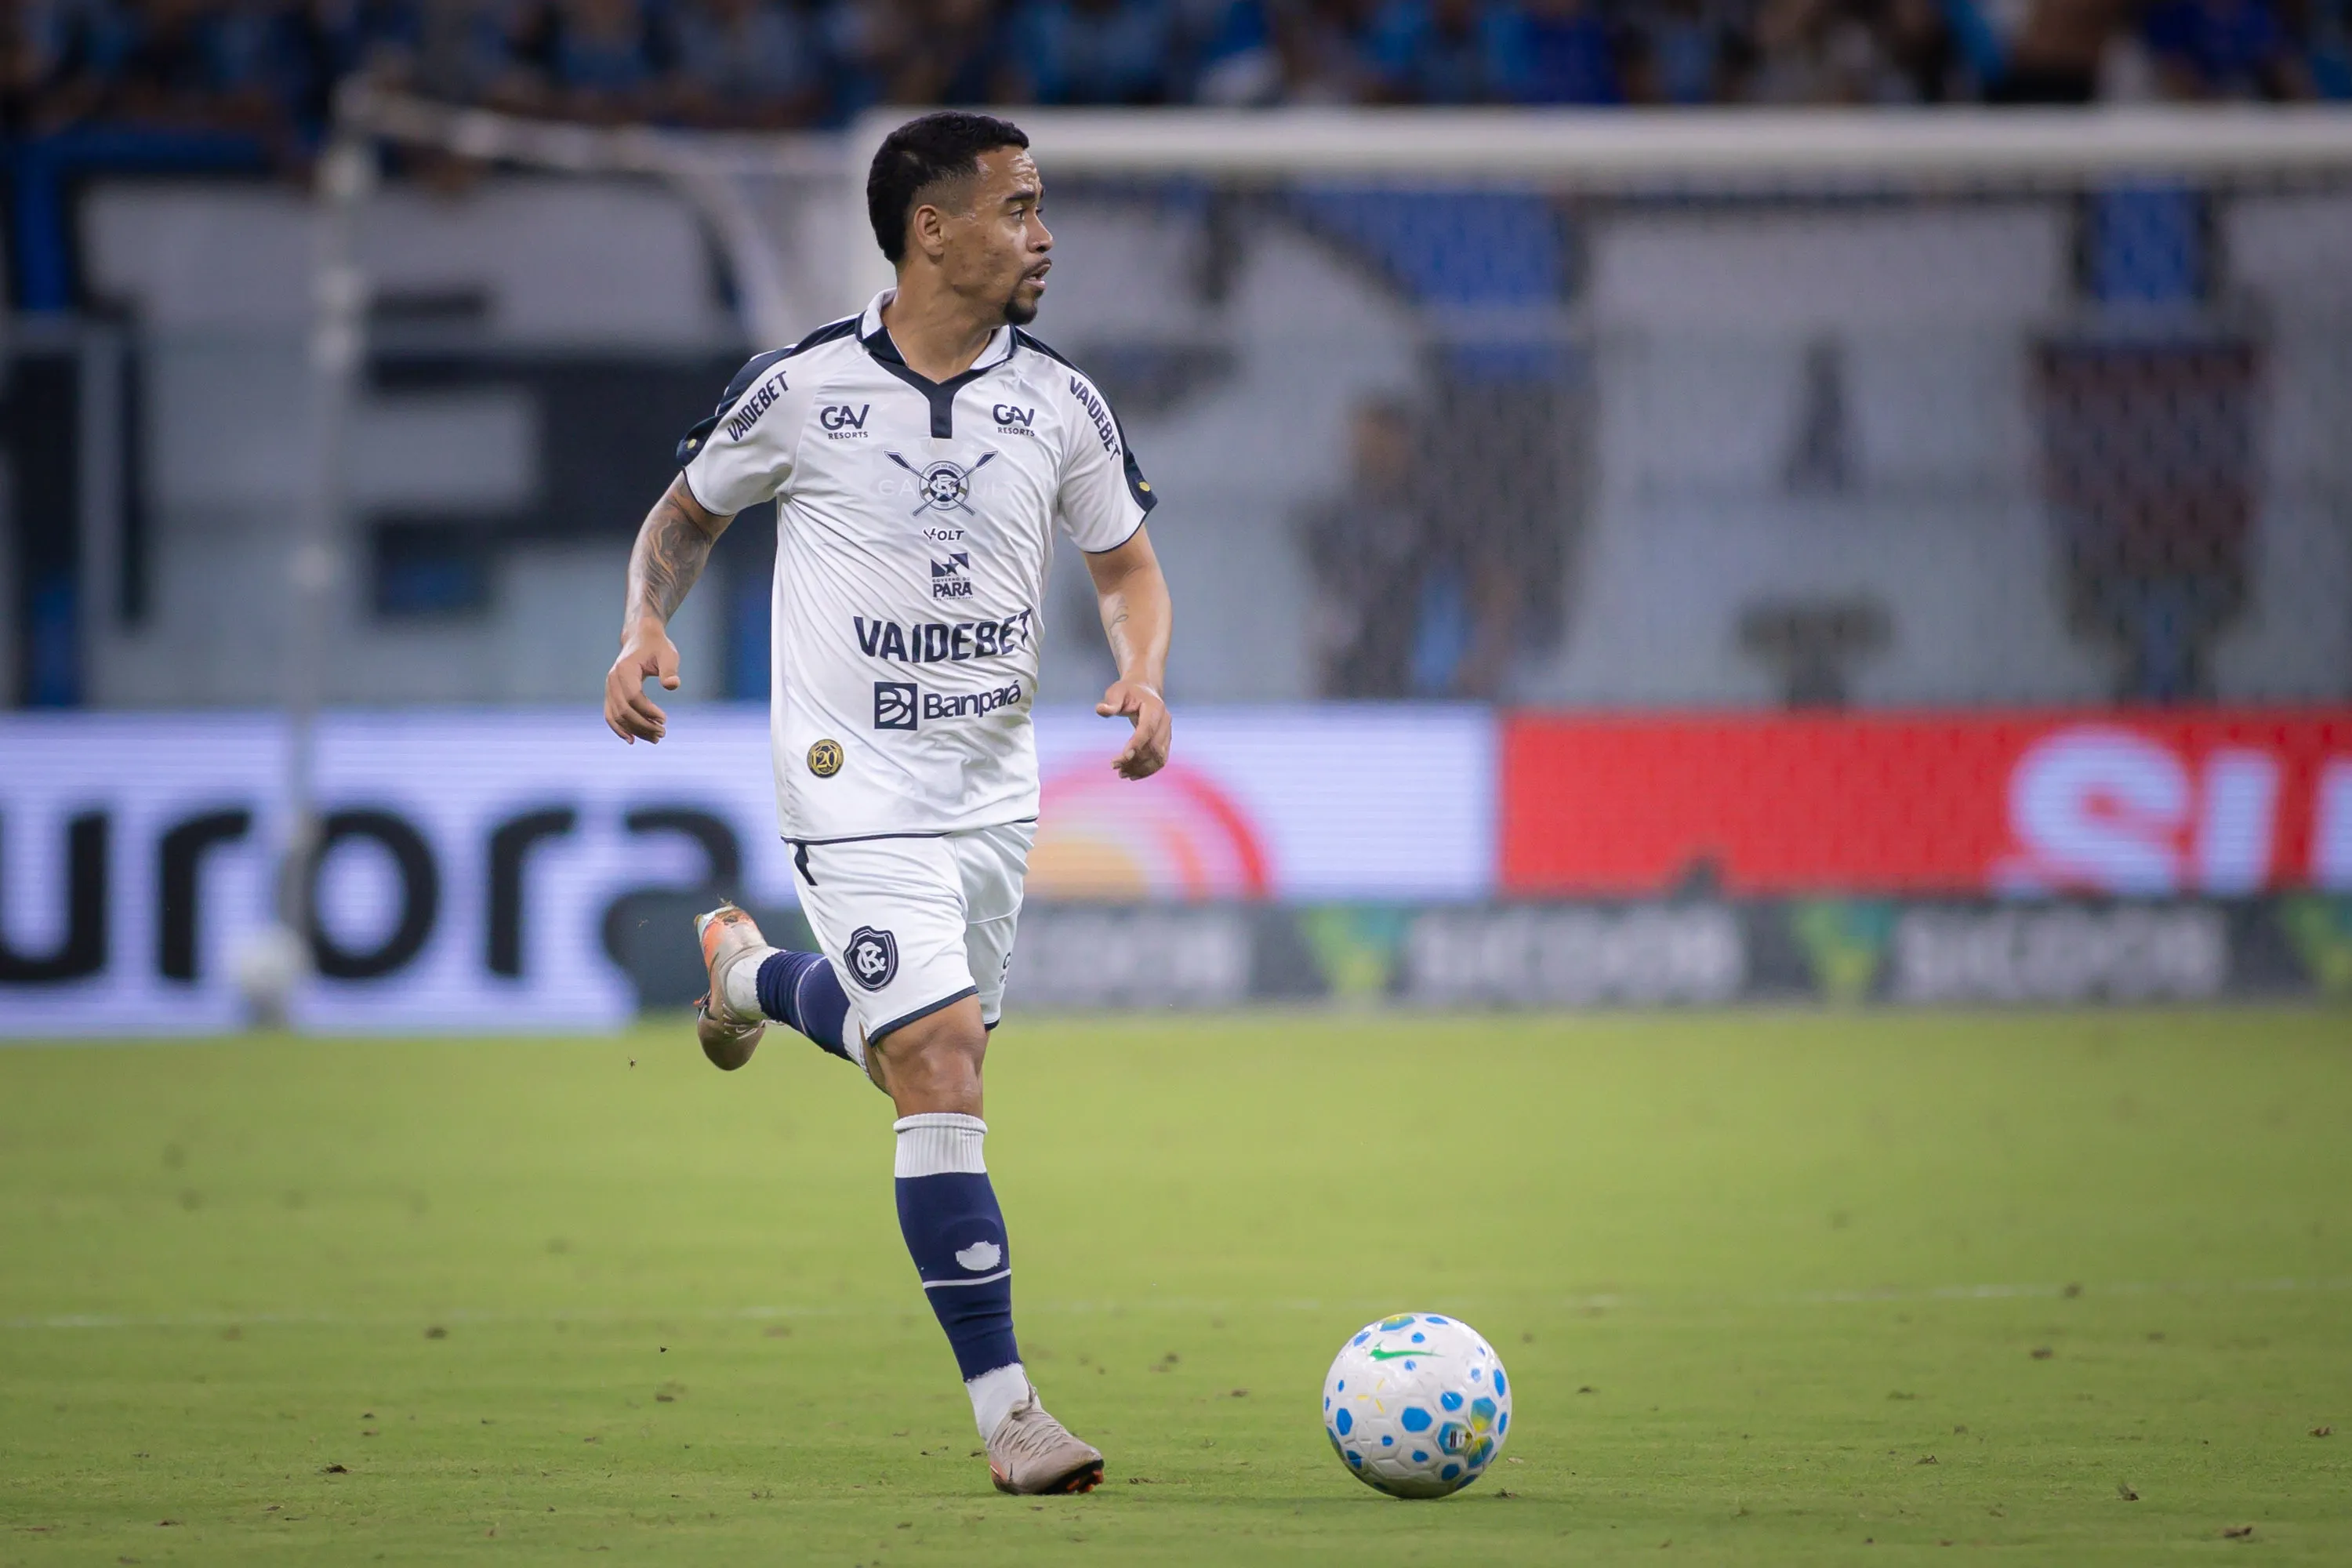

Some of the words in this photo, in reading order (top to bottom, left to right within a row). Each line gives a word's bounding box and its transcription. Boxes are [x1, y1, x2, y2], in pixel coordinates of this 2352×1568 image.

[728, 371, 789, 441] VAIDEBET
[820, 405, 869, 430] GAV
[993, 404, 1035, 426] GAV
[1069, 375, 1121, 461] VAIDEBET
[828, 431, 869, 440] RESORTS
[997, 426, 1035, 437] RESORTS
[923, 528, 964, 541] VOLT
[853, 608, 1032, 663] VAIDEBET
[924, 680, 1022, 719] Banpará
